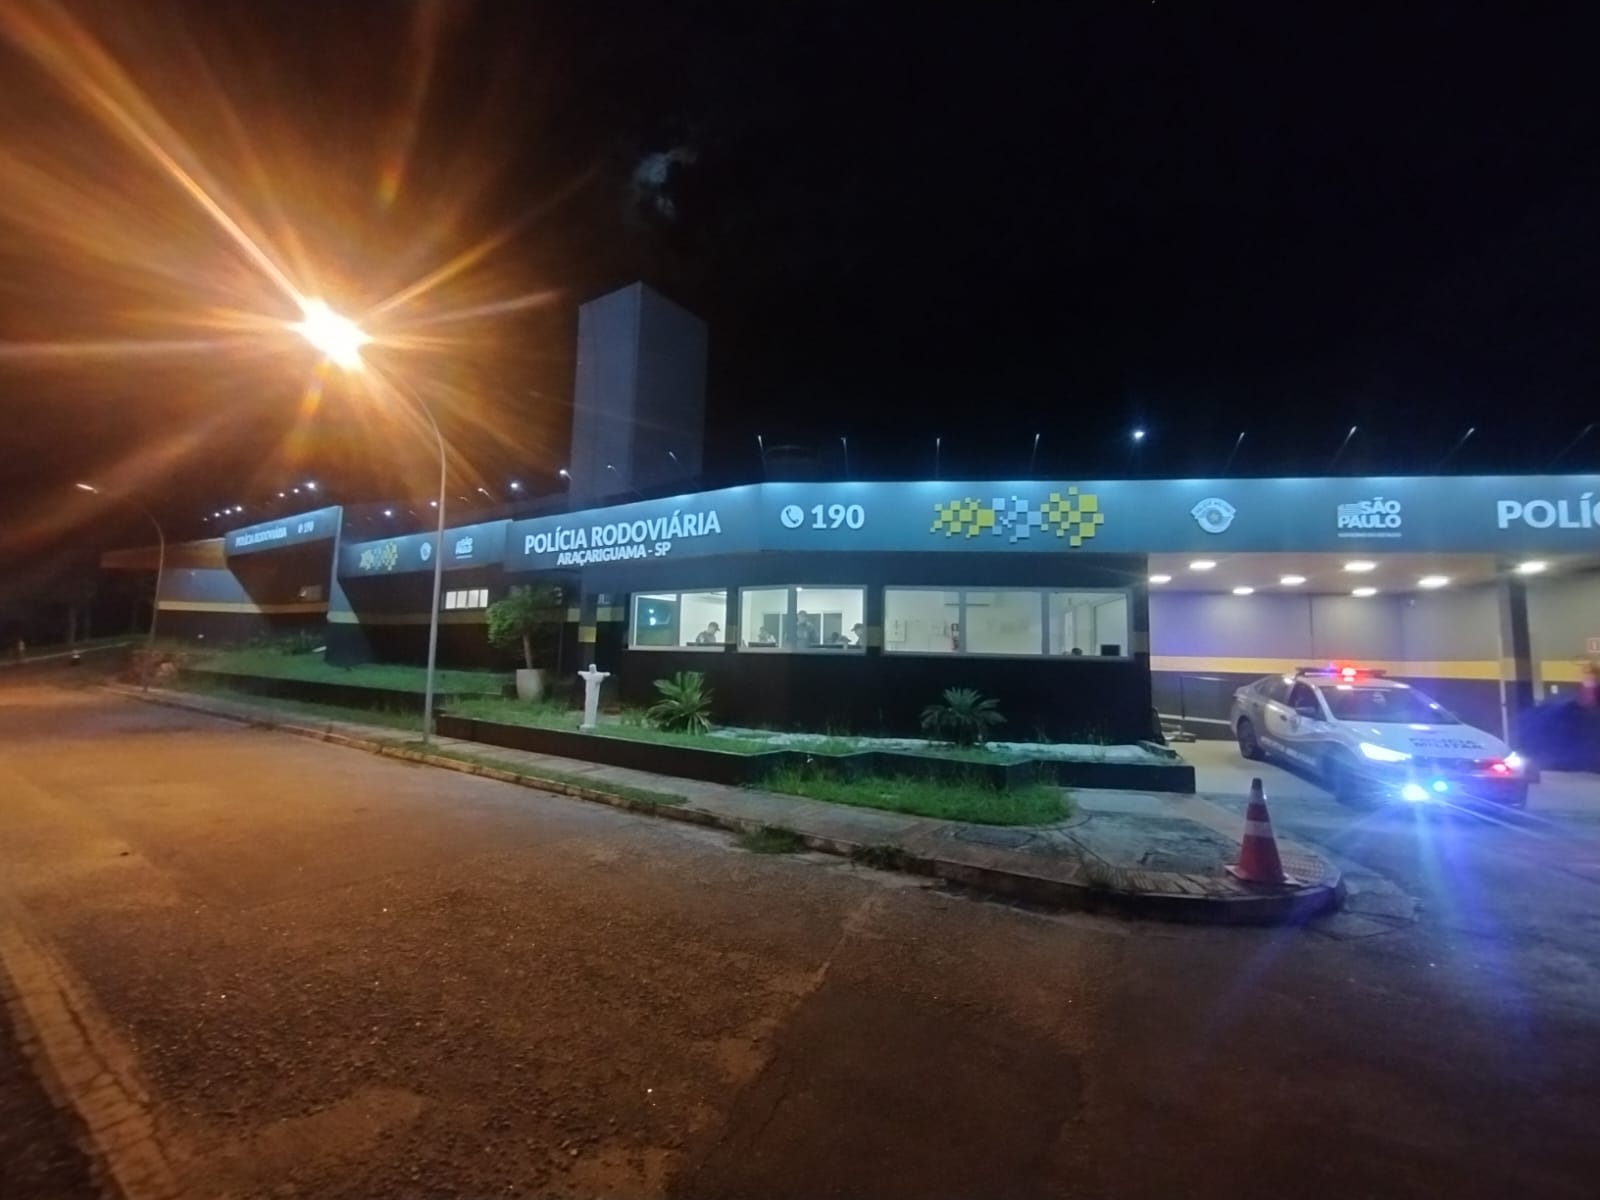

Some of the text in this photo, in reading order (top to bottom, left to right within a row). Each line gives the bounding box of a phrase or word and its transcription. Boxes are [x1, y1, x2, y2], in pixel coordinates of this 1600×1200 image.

[811, 504, 865, 529] 190
[1360, 496, 1401, 514] SÃO
[524, 509, 721, 555] POLÍCIA RODOVIÁRIA
[1337, 513, 1402, 529] PAULO
[556, 544, 647, 567] ARAÇARIGUAMA
[654, 541, 672, 557] SP
